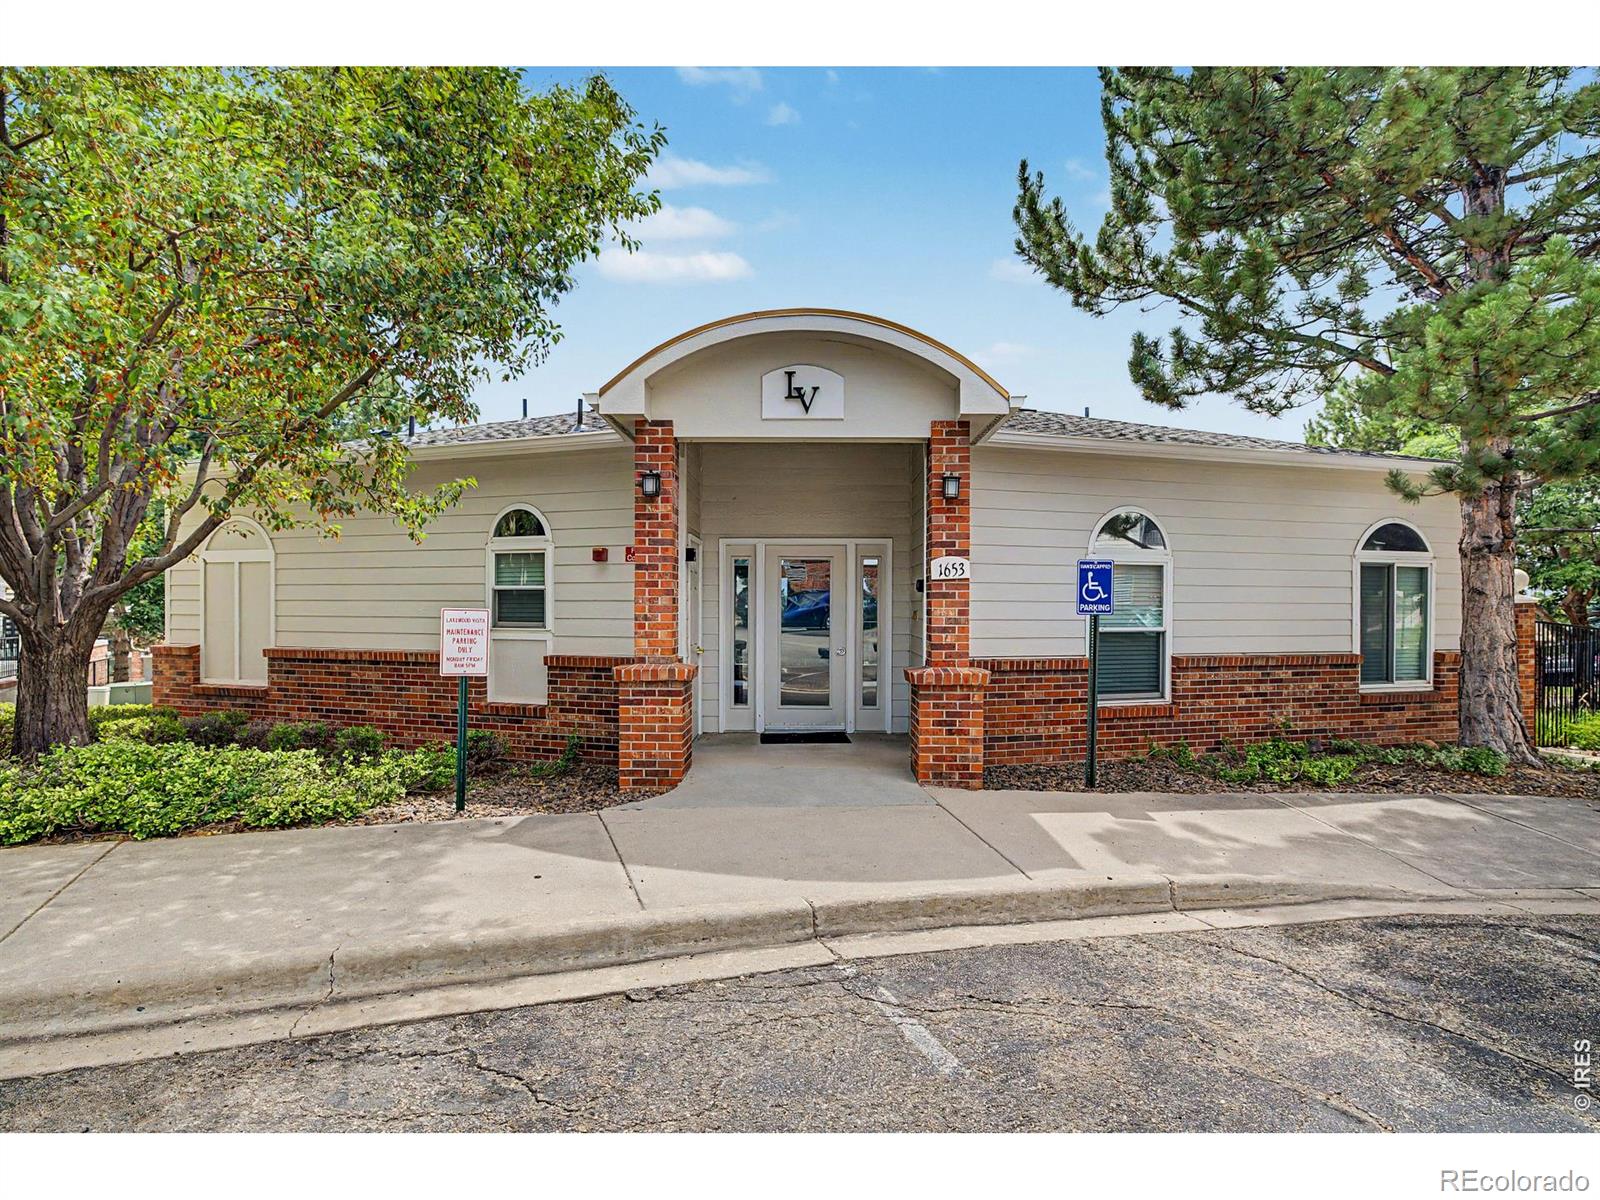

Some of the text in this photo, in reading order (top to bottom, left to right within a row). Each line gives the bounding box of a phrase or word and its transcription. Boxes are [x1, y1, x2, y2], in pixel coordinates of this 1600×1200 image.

[784, 371, 820, 414] LV
[939, 562, 965, 577] 1653
[446, 628, 484, 636] MAINTENANCE
